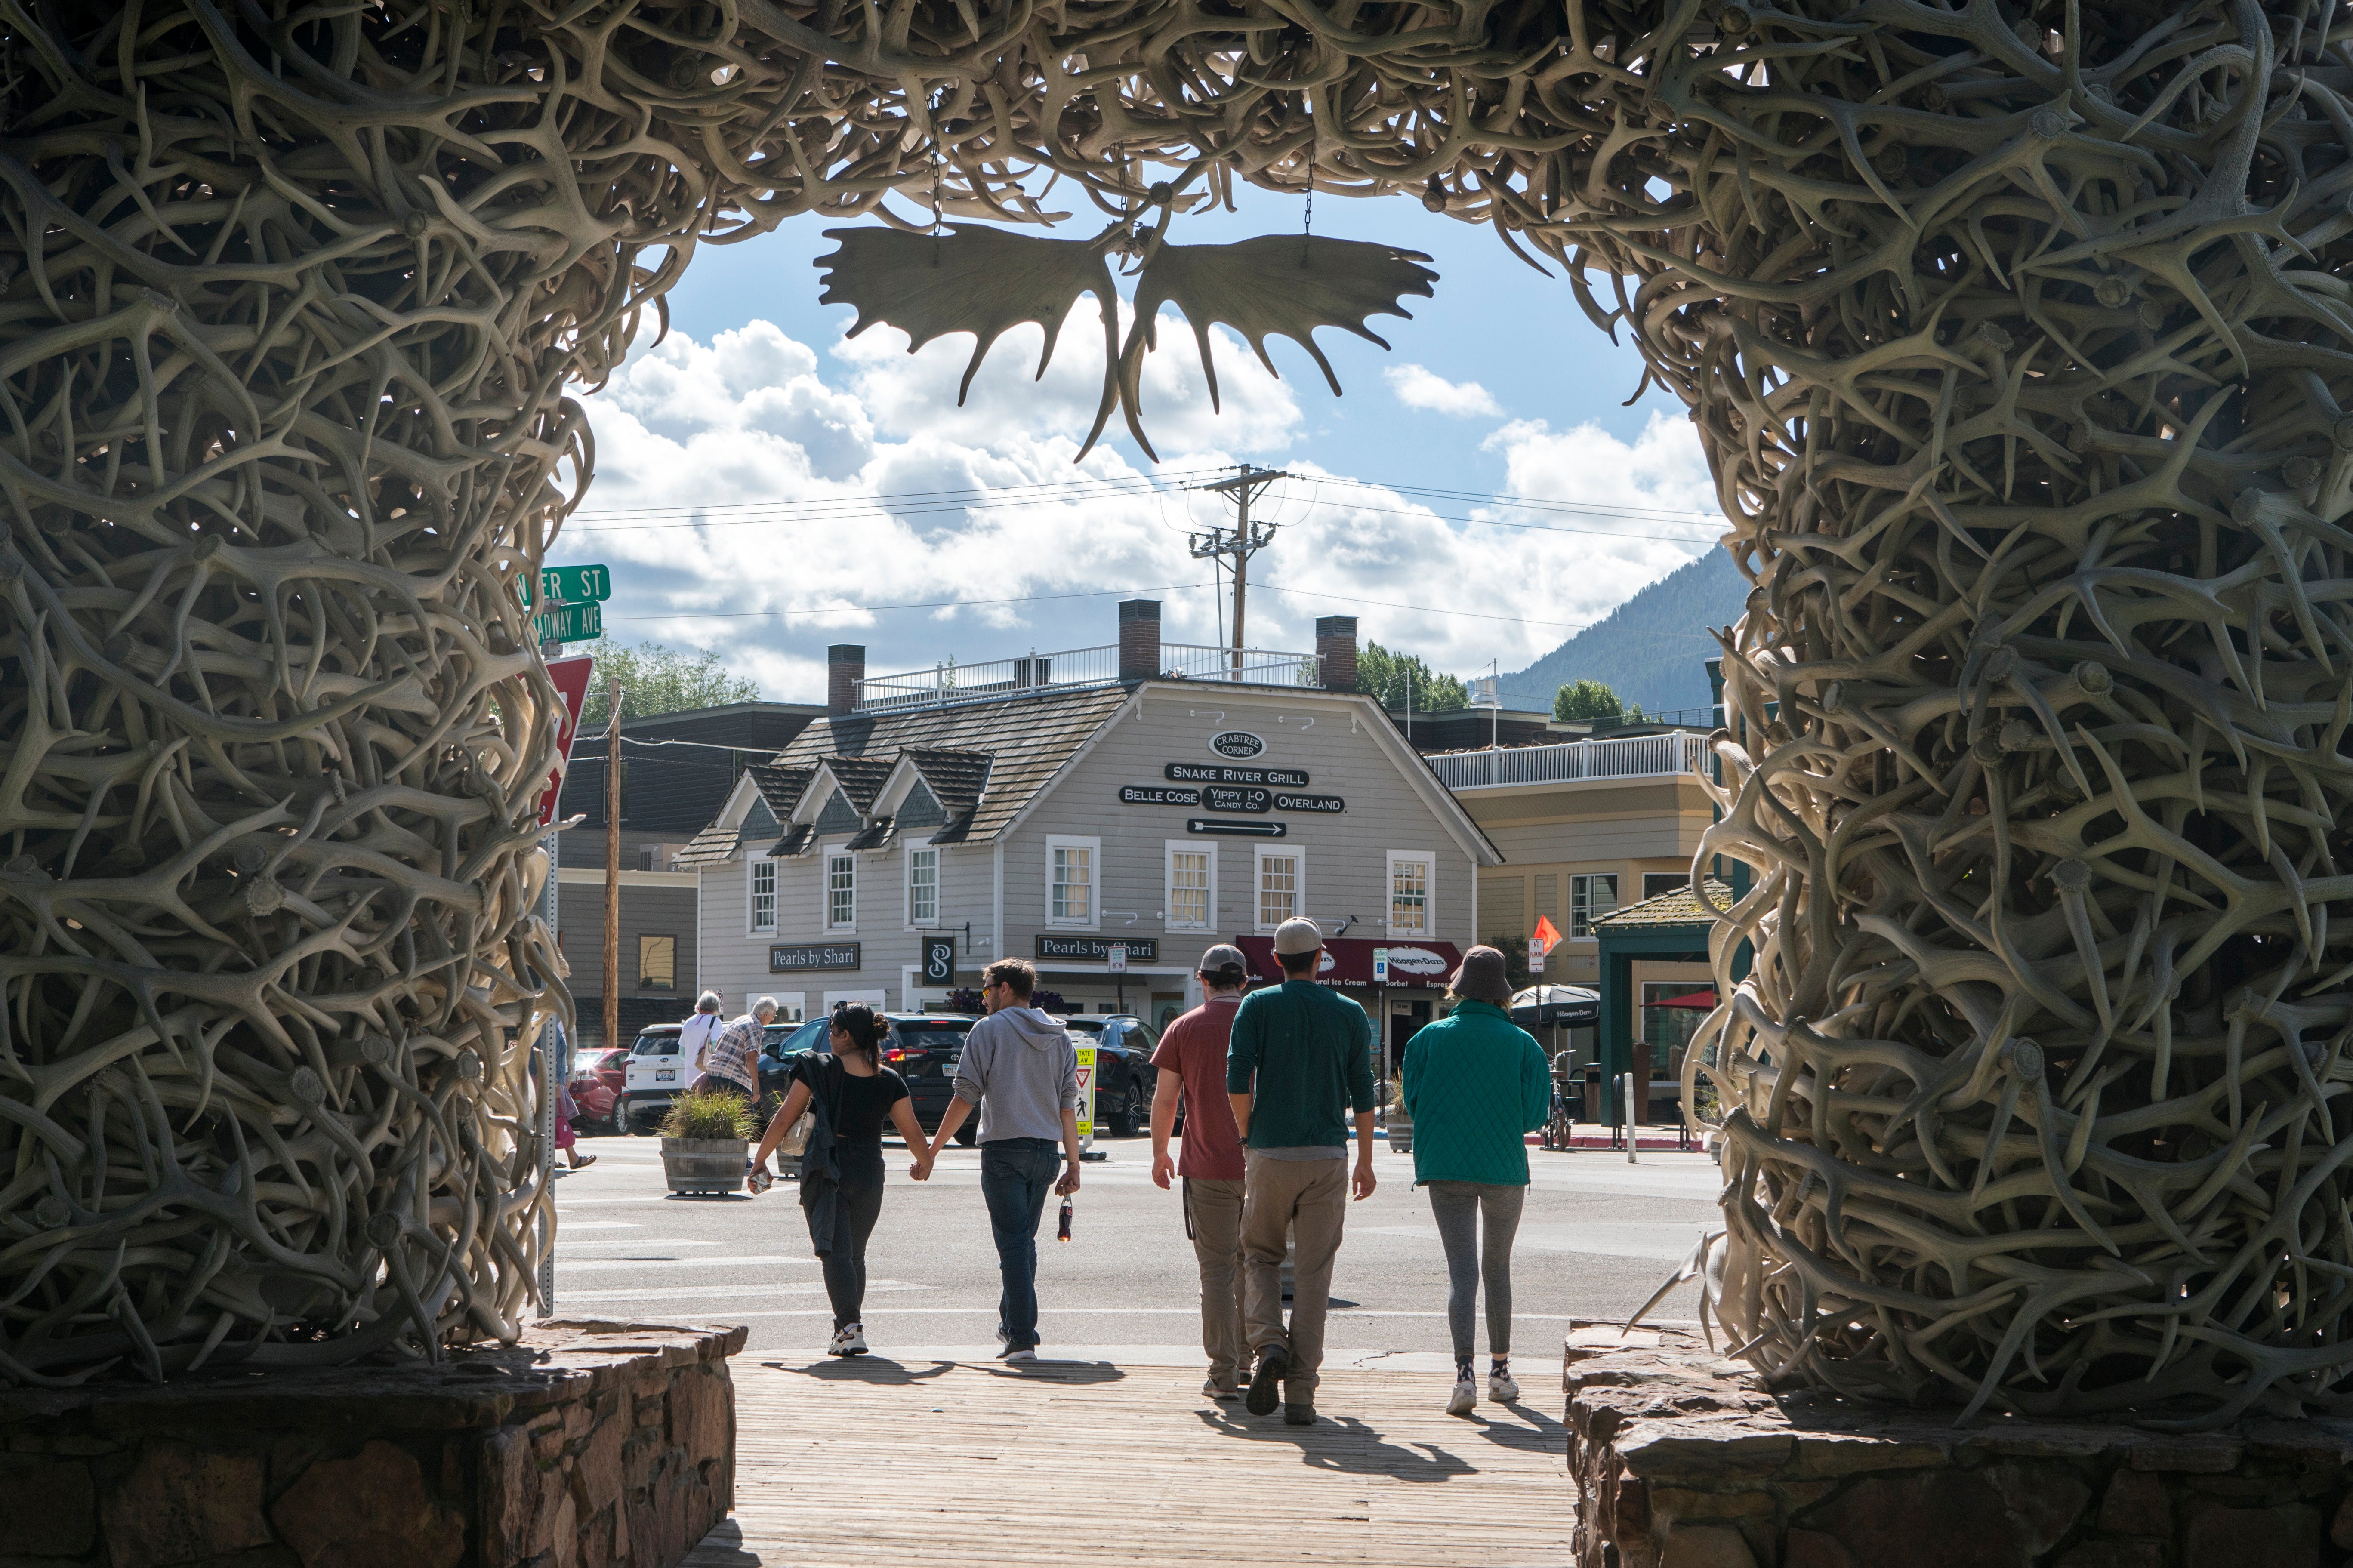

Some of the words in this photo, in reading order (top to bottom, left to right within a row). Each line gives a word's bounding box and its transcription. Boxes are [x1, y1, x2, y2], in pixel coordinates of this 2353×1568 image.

[518, 573, 562, 601] NER
[581, 570, 600, 597] ST
[538, 610, 571, 640] ADWAY
[582, 606, 600, 635] AVE
[1216, 735, 1259, 748] CRABTREE
[1222, 745, 1254, 755] CORNER
[1173, 767, 1216, 779] SNAKE
[1224, 769, 1261, 782] RIVER
[1268, 772, 1304, 784] GRILL
[1125, 789, 1163, 801] BELLE
[1166, 791, 1198, 803] COSE
[1210, 789, 1241, 800] YIPPY
[1248, 791, 1264, 801] I-O
[1215, 801, 1242, 809] CANDY
[1278, 796, 1341, 810] OVERLAND
[1043, 940, 1087, 954] Pearls
[1092, 942, 1108, 958] by
[774, 950, 805, 965] Pearls
[808, 950, 821, 967] by
[824, 948, 854, 964] Shari
[1388, 957, 1444, 966] Häagen-Dazs
[1345, 978, 1367, 986] Cream
[1426, 980, 1451, 989] Espres
